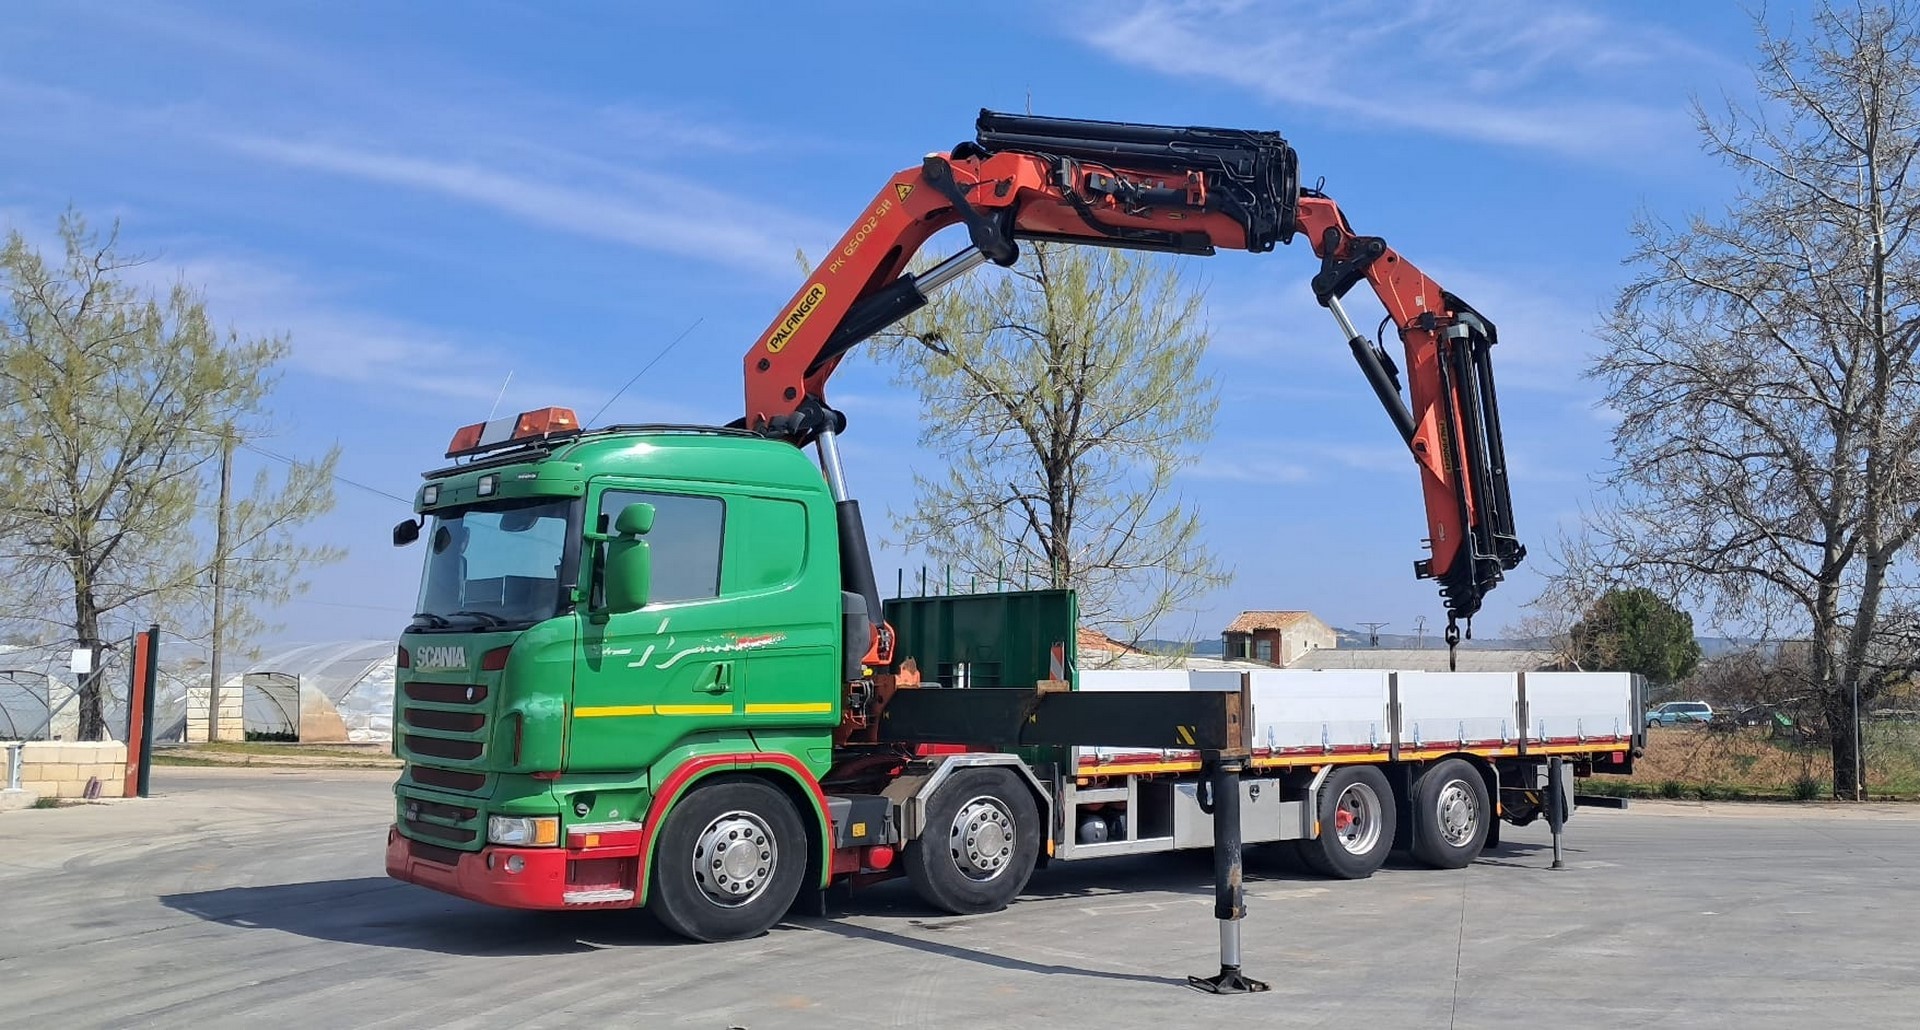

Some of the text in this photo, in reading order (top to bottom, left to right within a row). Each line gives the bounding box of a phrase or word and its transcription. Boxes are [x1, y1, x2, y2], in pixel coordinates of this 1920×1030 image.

[829, 199, 892, 274] PK 65002 SH
[769, 287, 823, 349] PALFINGER
[416, 646, 466, 667] SCANIA
